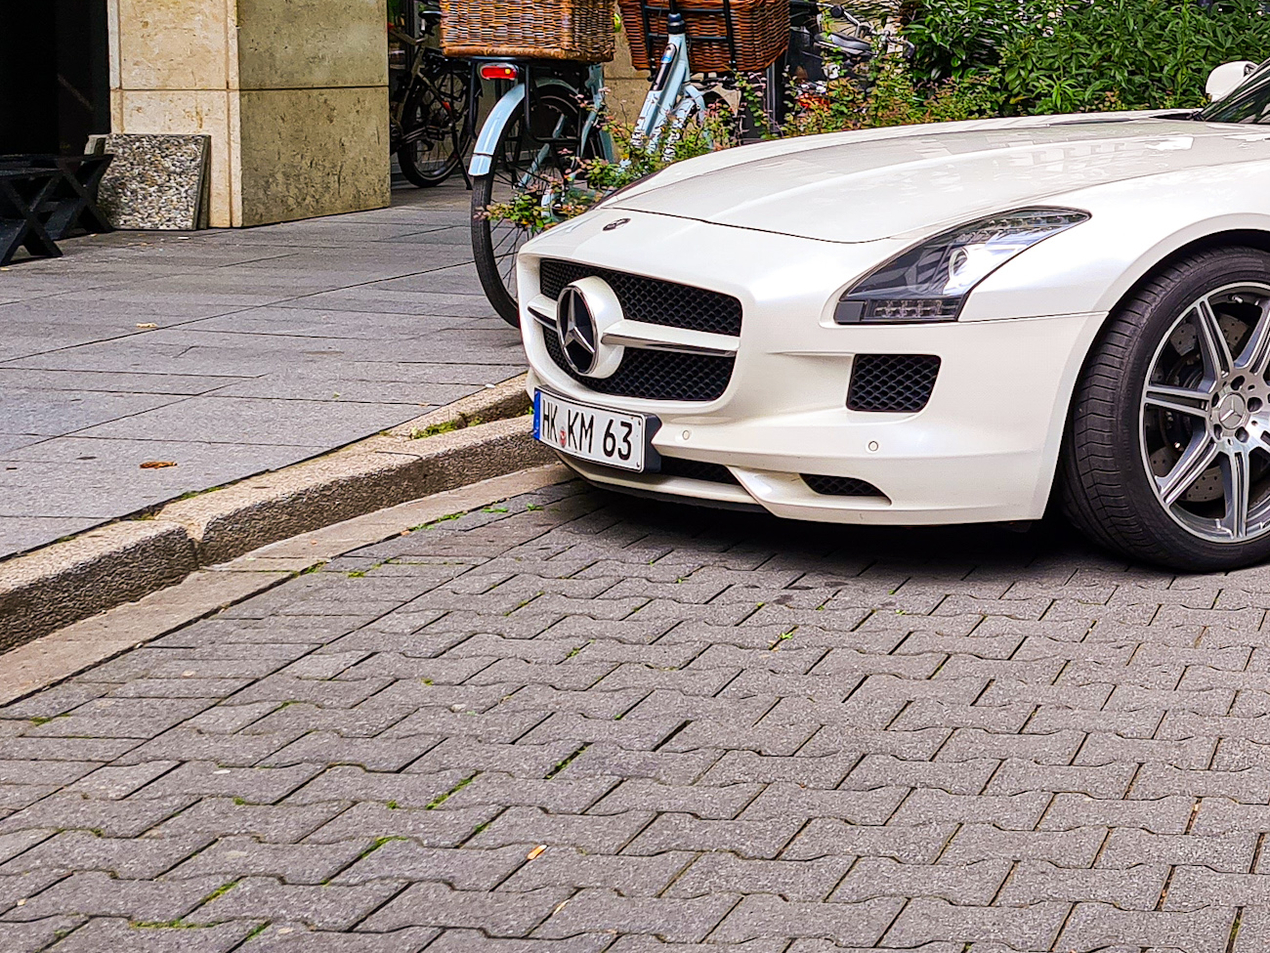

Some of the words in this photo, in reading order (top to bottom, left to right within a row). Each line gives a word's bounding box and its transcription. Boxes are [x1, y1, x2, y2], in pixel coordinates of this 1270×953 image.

[542, 398, 559, 443] HK
[567, 409, 595, 454] KM
[603, 419, 633, 461] 63
